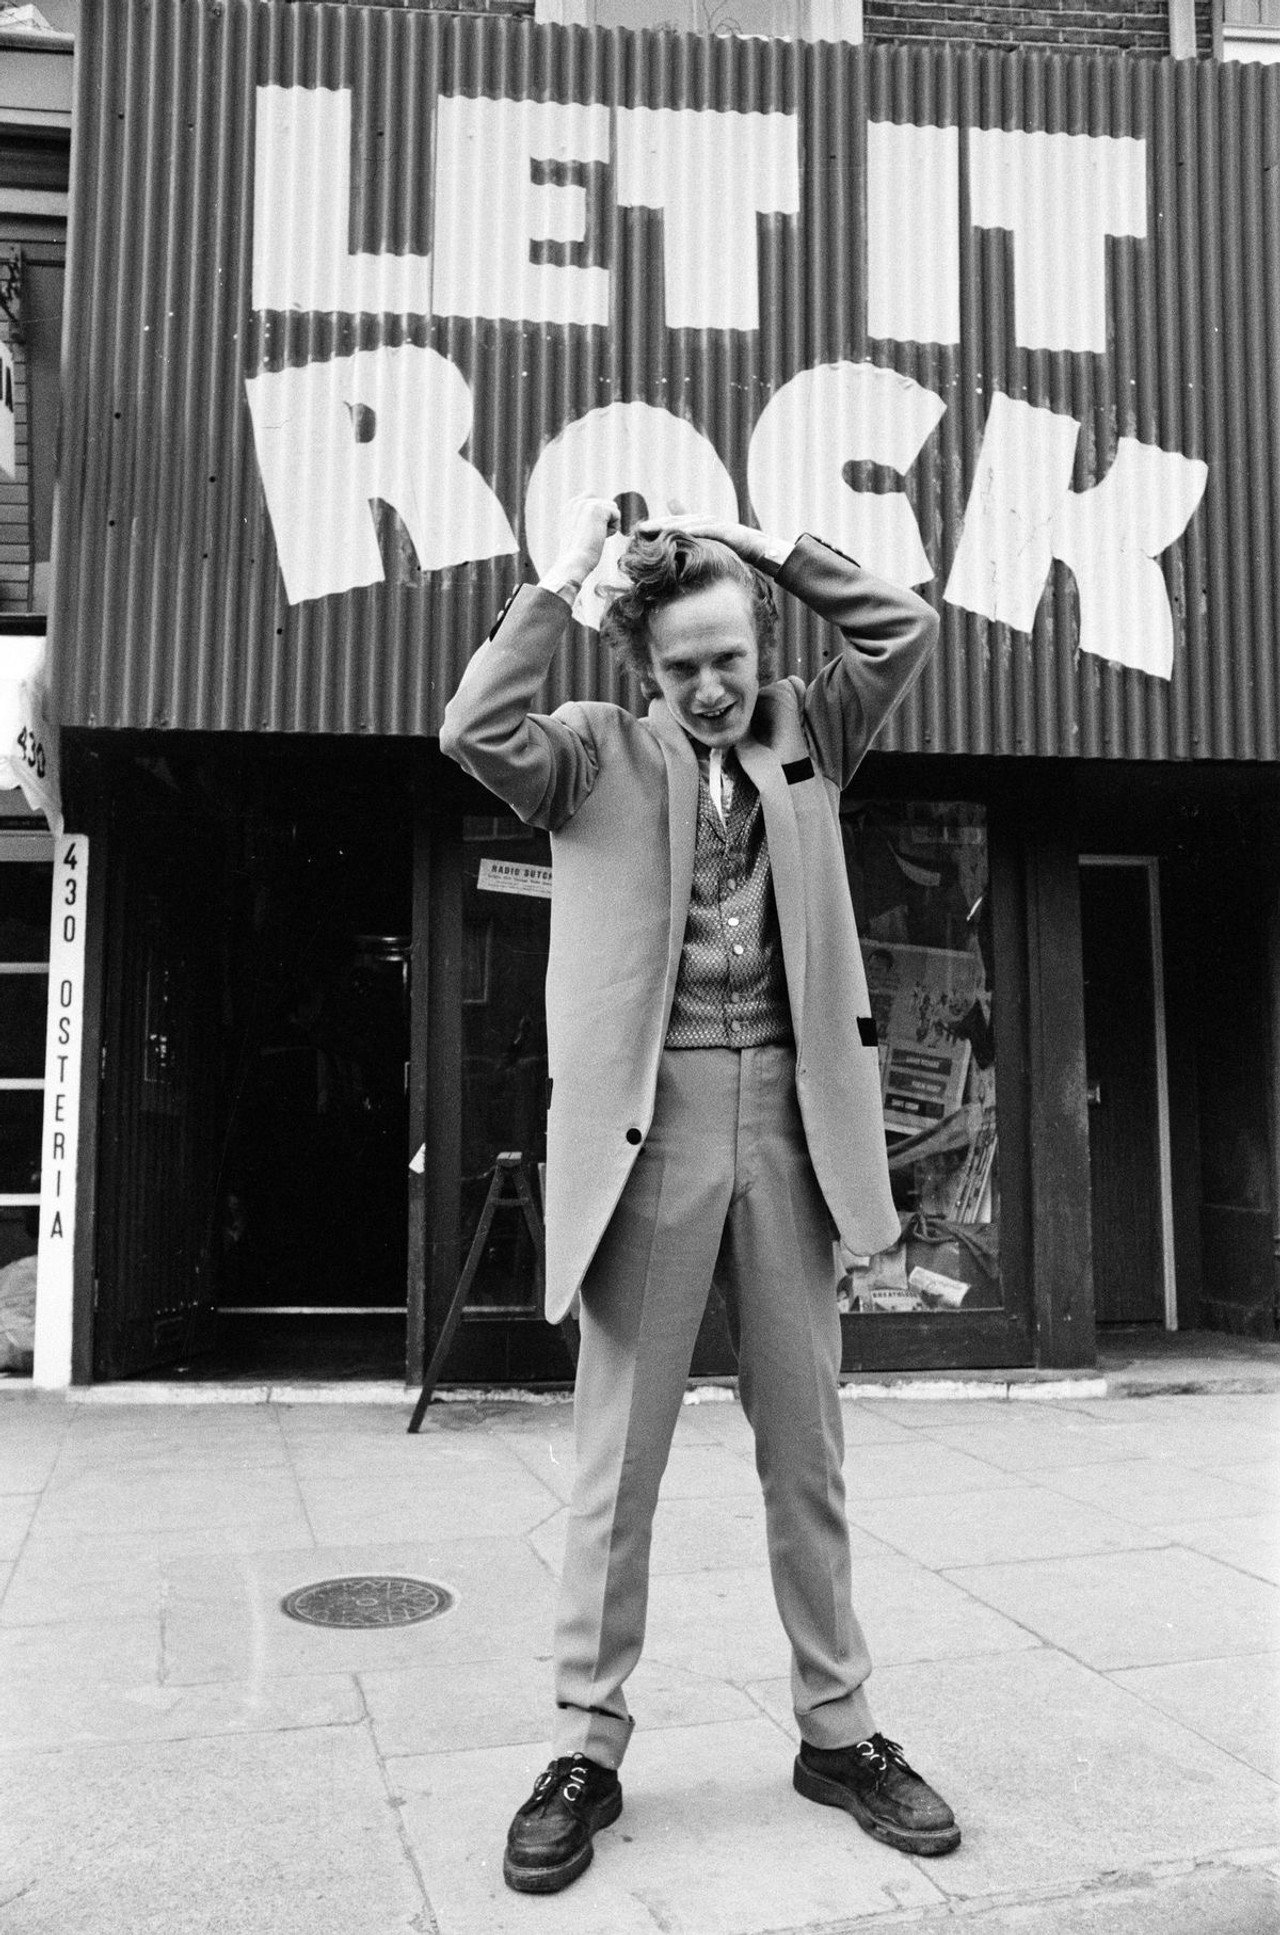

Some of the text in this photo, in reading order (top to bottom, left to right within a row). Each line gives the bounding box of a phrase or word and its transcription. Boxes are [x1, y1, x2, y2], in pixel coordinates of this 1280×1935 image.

[252, 84, 1148, 354] LET IT
[245, 343, 1208, 681] ROCK
[17, 725, 46, 778] 430
[491, 865, 520, 876] RADIO
[50, 842, 78, 1239] 430 OSTERIA
